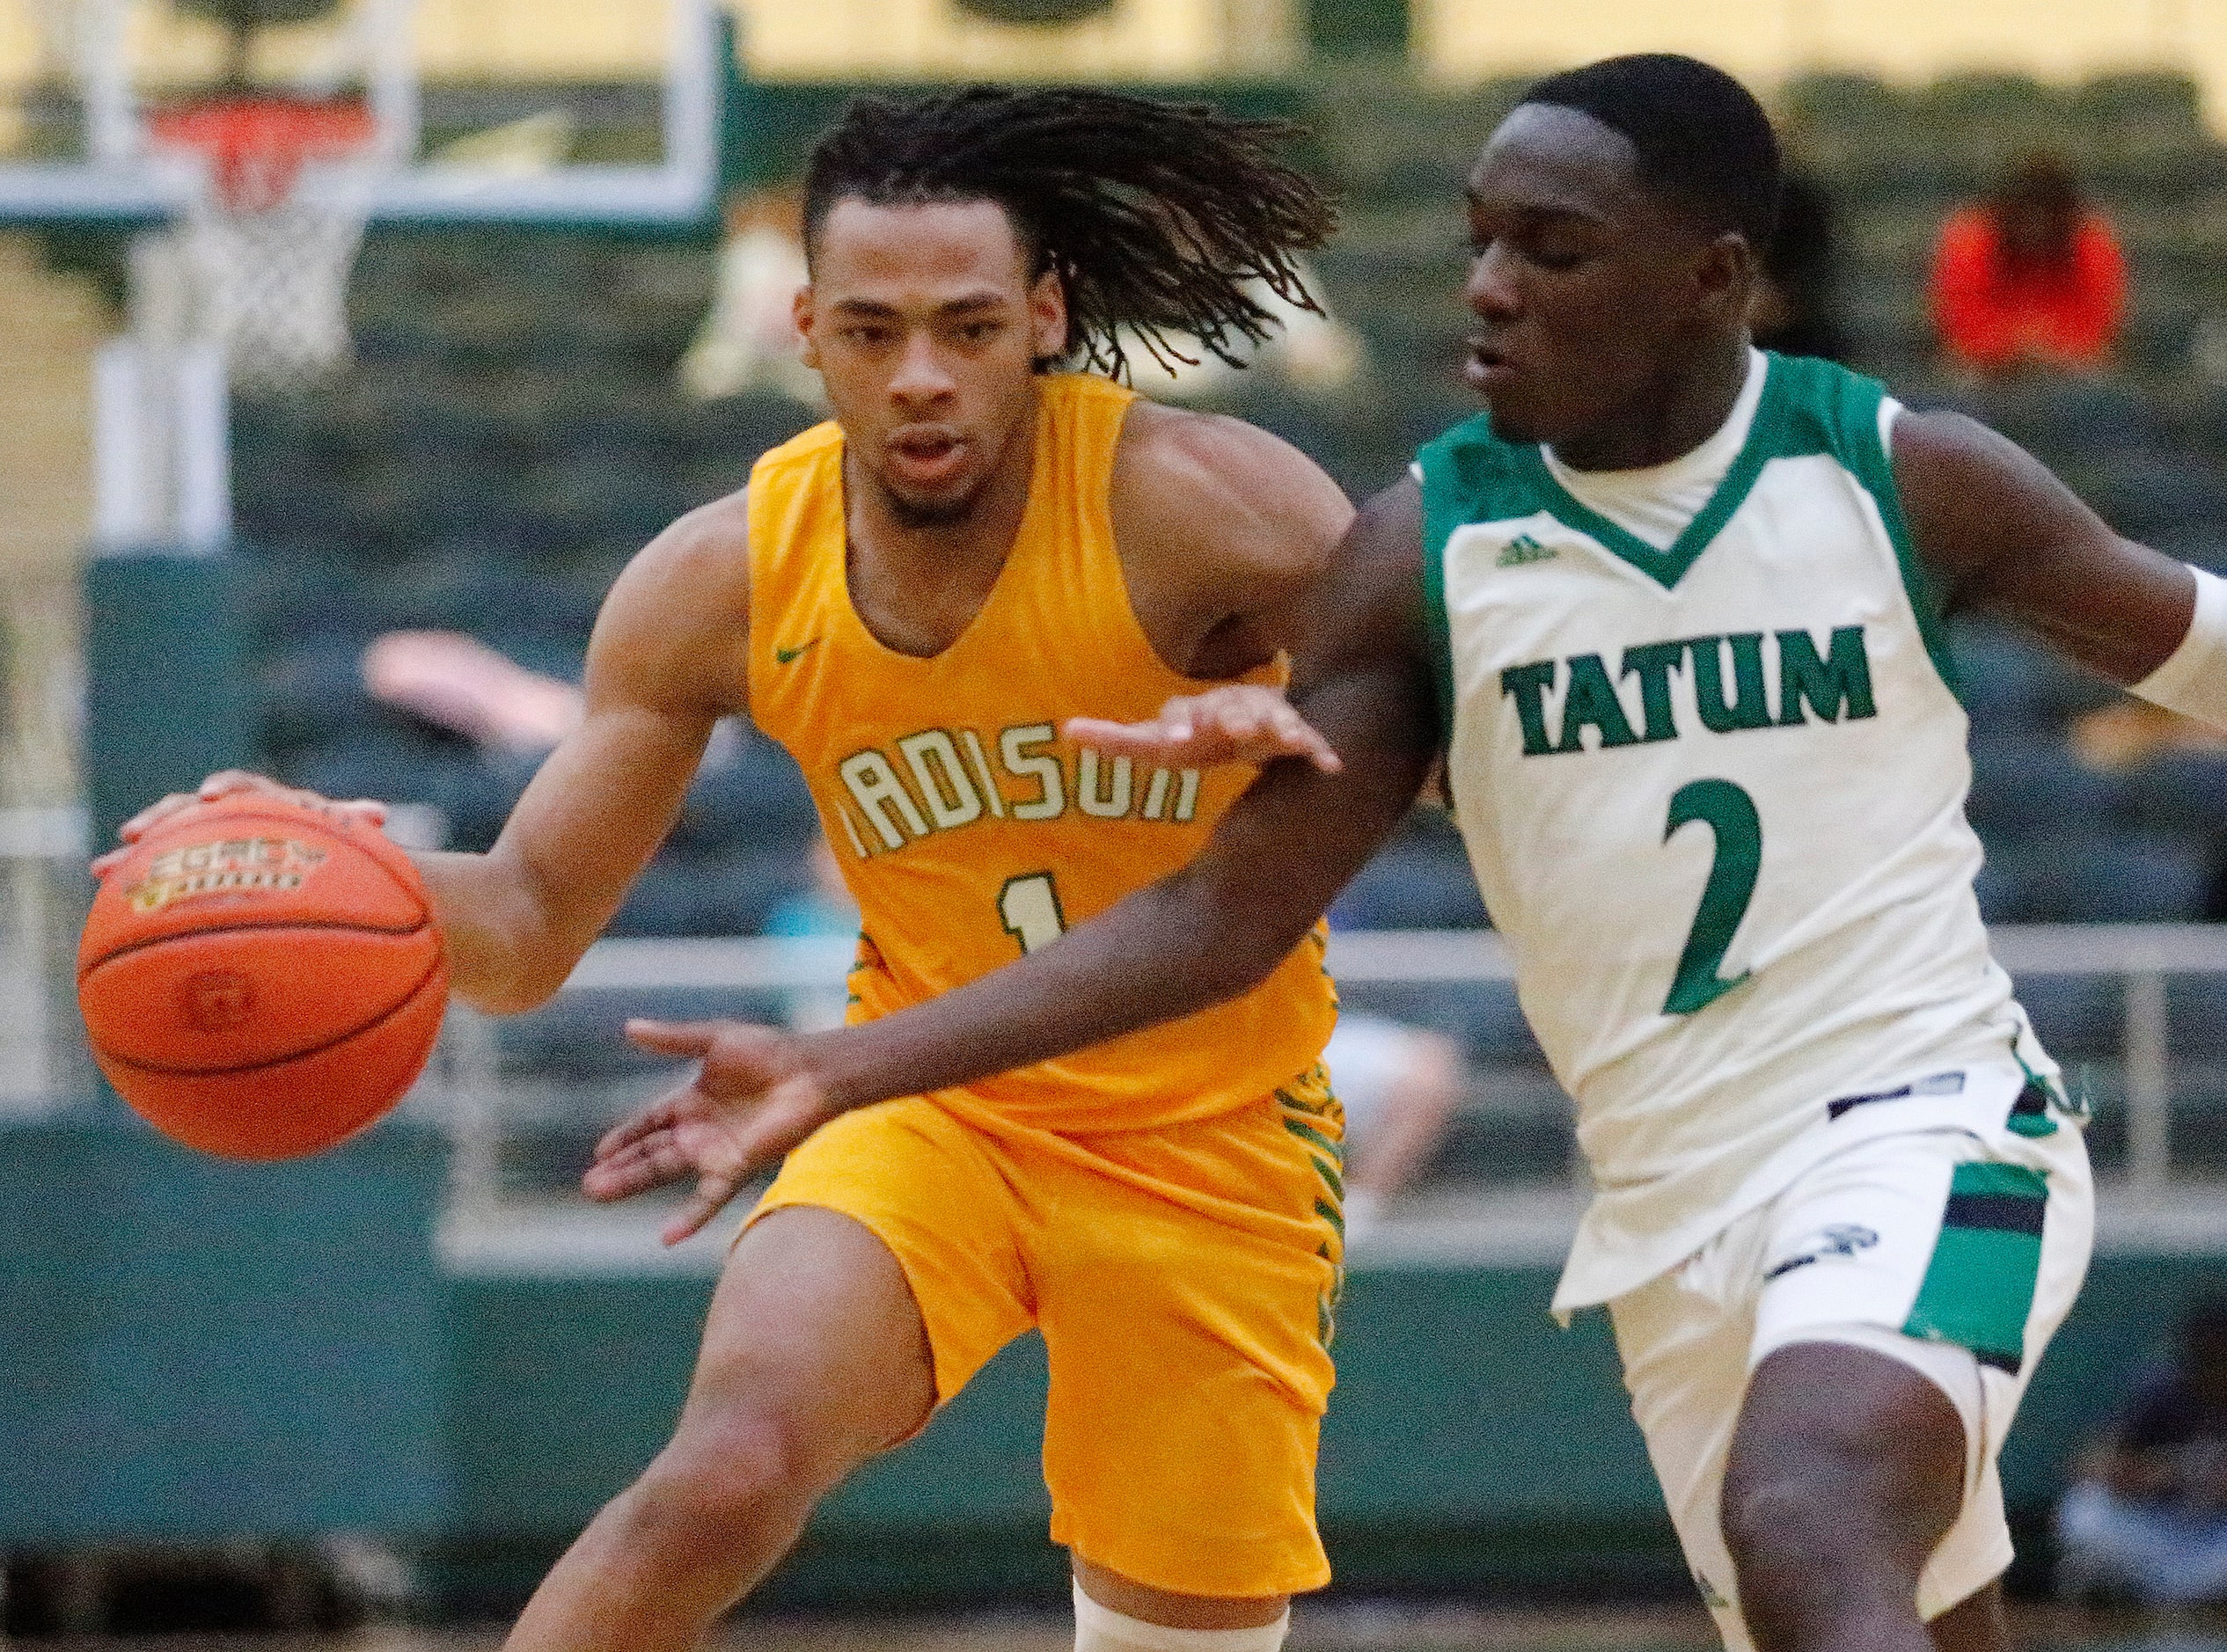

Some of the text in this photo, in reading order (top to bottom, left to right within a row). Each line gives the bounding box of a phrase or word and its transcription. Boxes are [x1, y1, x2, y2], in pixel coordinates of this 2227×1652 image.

[1499, 624, 1878, 757] TATUM
[835, 720, 1203, 861] ADISON
[996, 871, 1066, 954] 1
[1659, 777, 1762, 1015] 2
